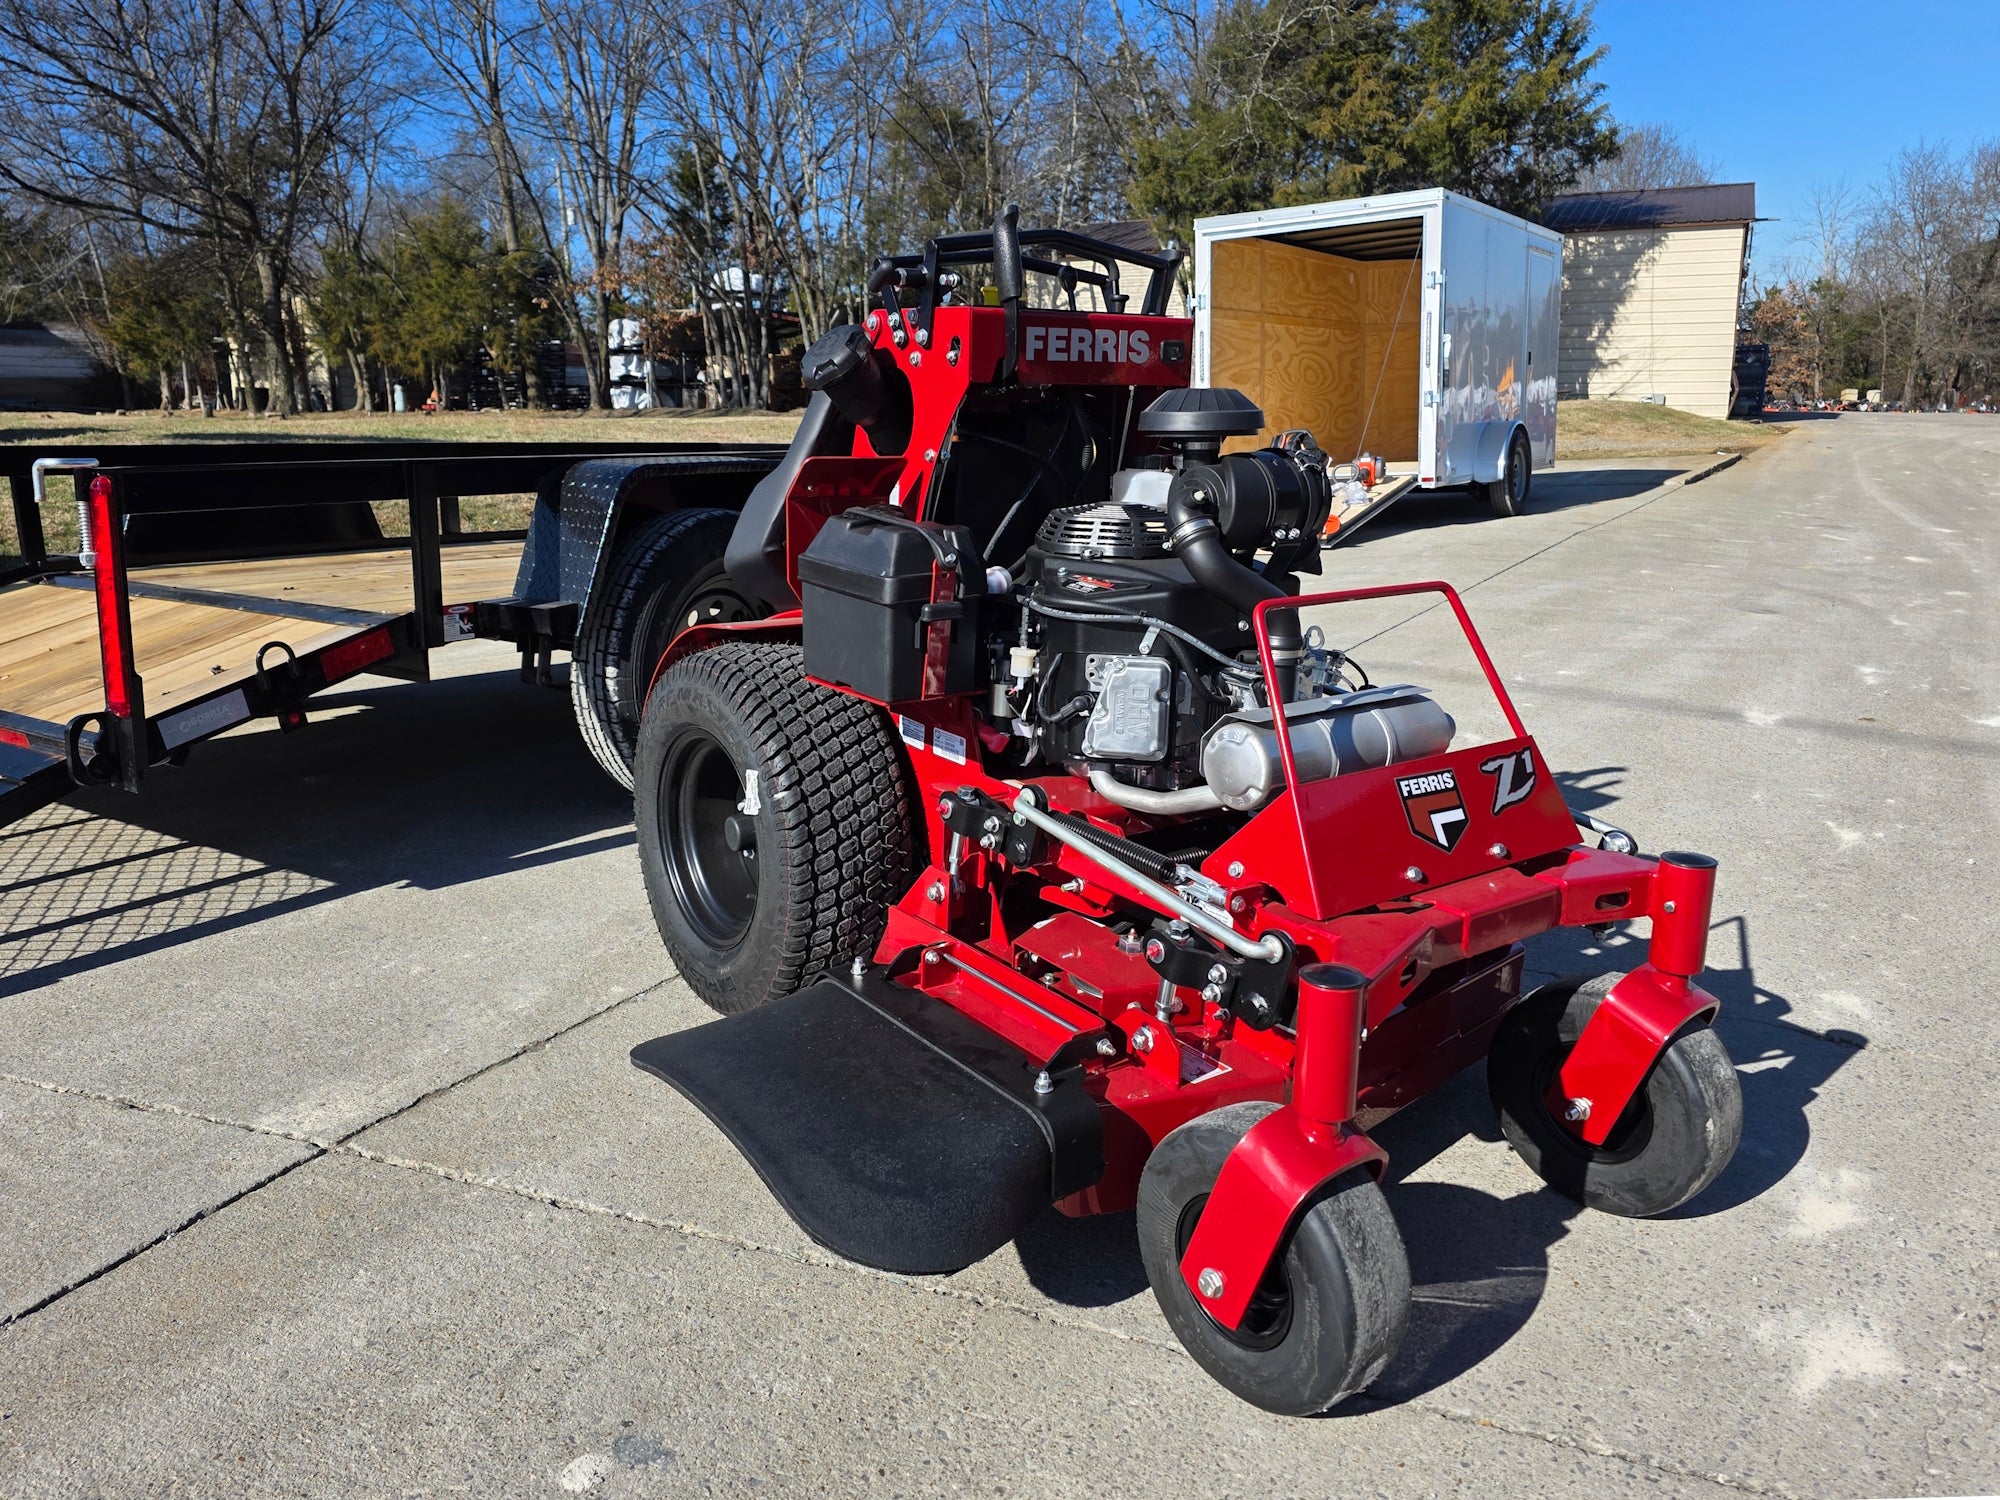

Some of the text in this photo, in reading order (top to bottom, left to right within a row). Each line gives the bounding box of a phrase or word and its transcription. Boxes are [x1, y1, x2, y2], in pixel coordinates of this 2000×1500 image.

[1025, 326, 1150, 364] FERRIS
[190, 704, 230, 725] GORILLA
[1128, 684, 1150, 738] OHV
[1400, 773, 1454, 796] FERRIS
[1481, 749, 1535, 813] Z1
